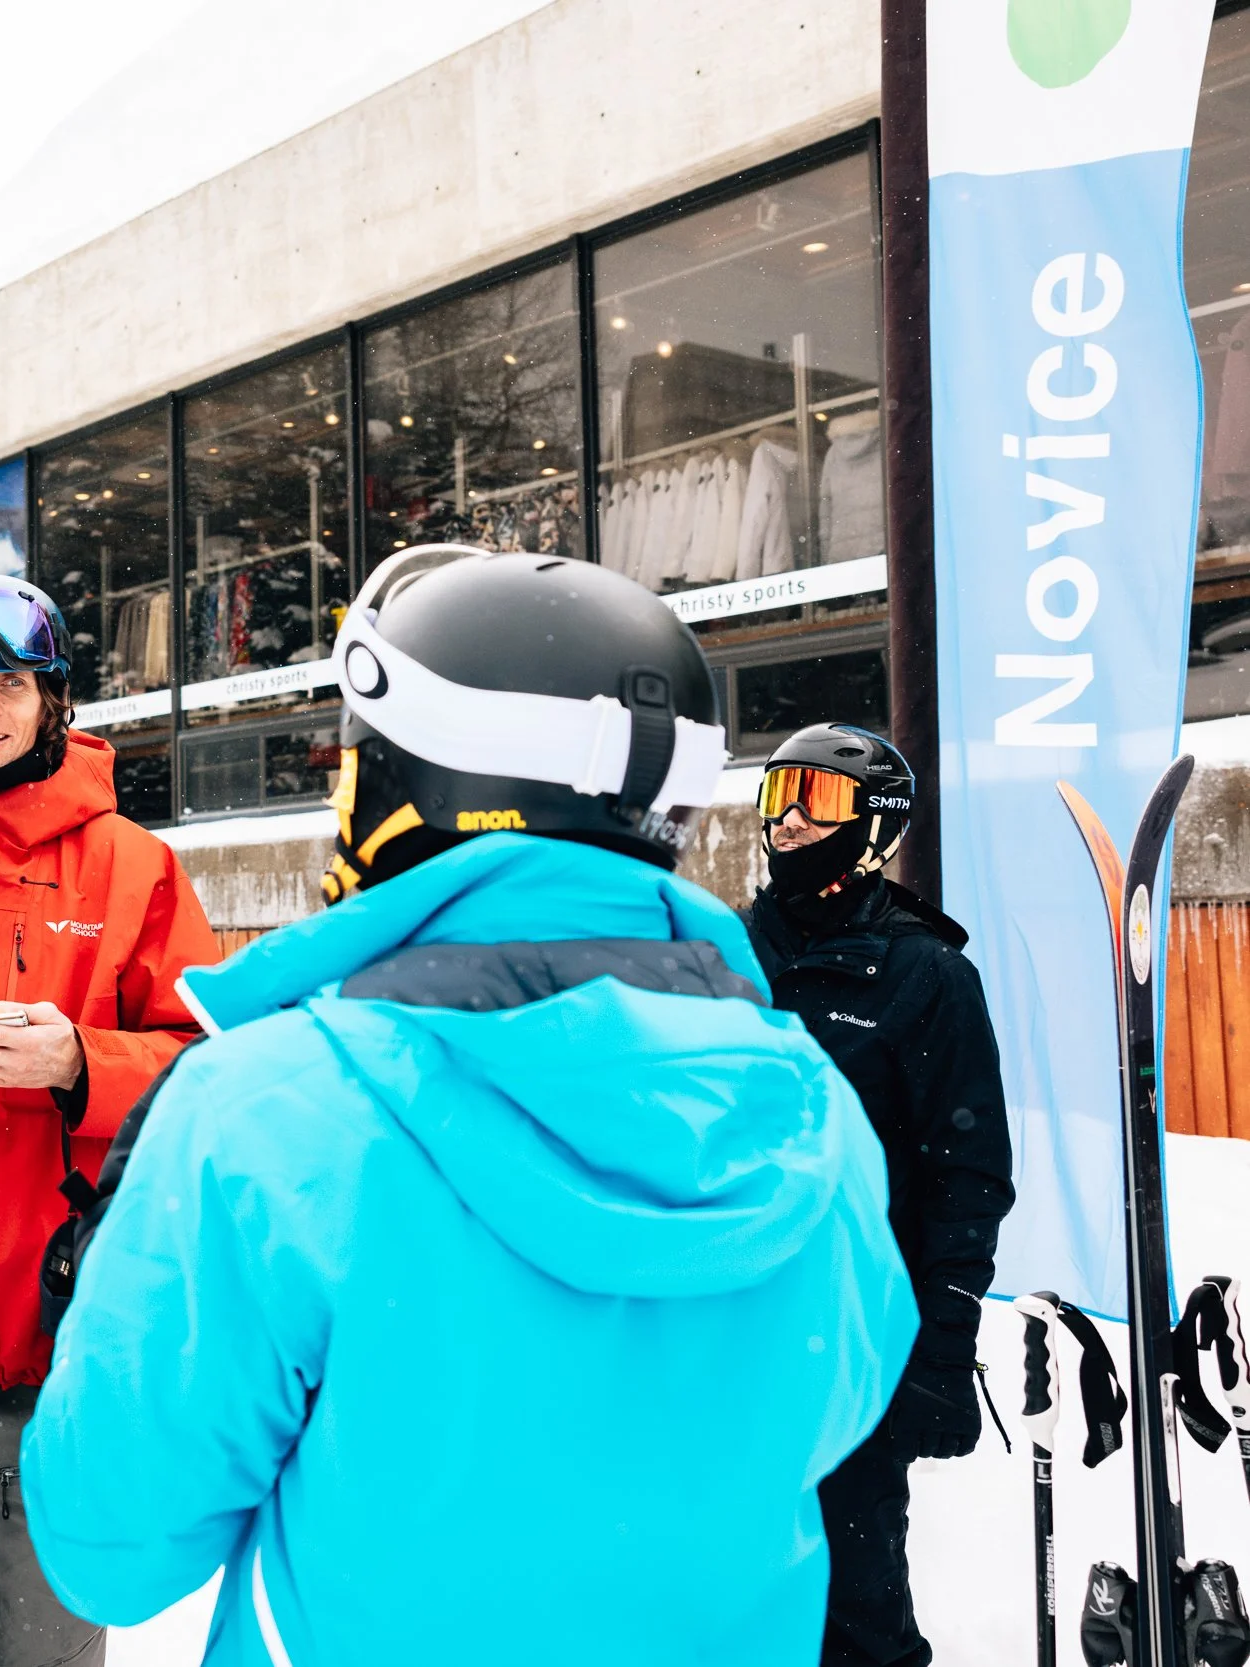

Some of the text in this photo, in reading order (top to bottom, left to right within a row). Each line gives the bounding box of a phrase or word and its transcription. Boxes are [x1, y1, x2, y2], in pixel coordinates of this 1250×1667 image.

[995, 252, 1125, 747] Novice
[744, 579, 806, 605] sports
[226, 670, 308, 695] christy sports
[76, 706, 104, 722] hristy
[868, 795, 910, 810] SMITH
[70, 920, 104, 932] MOUNTAIN
[70, 927, 99, 937] SCHOOL
[1045, 1533, 1056, 1617] KOMPERDELL
